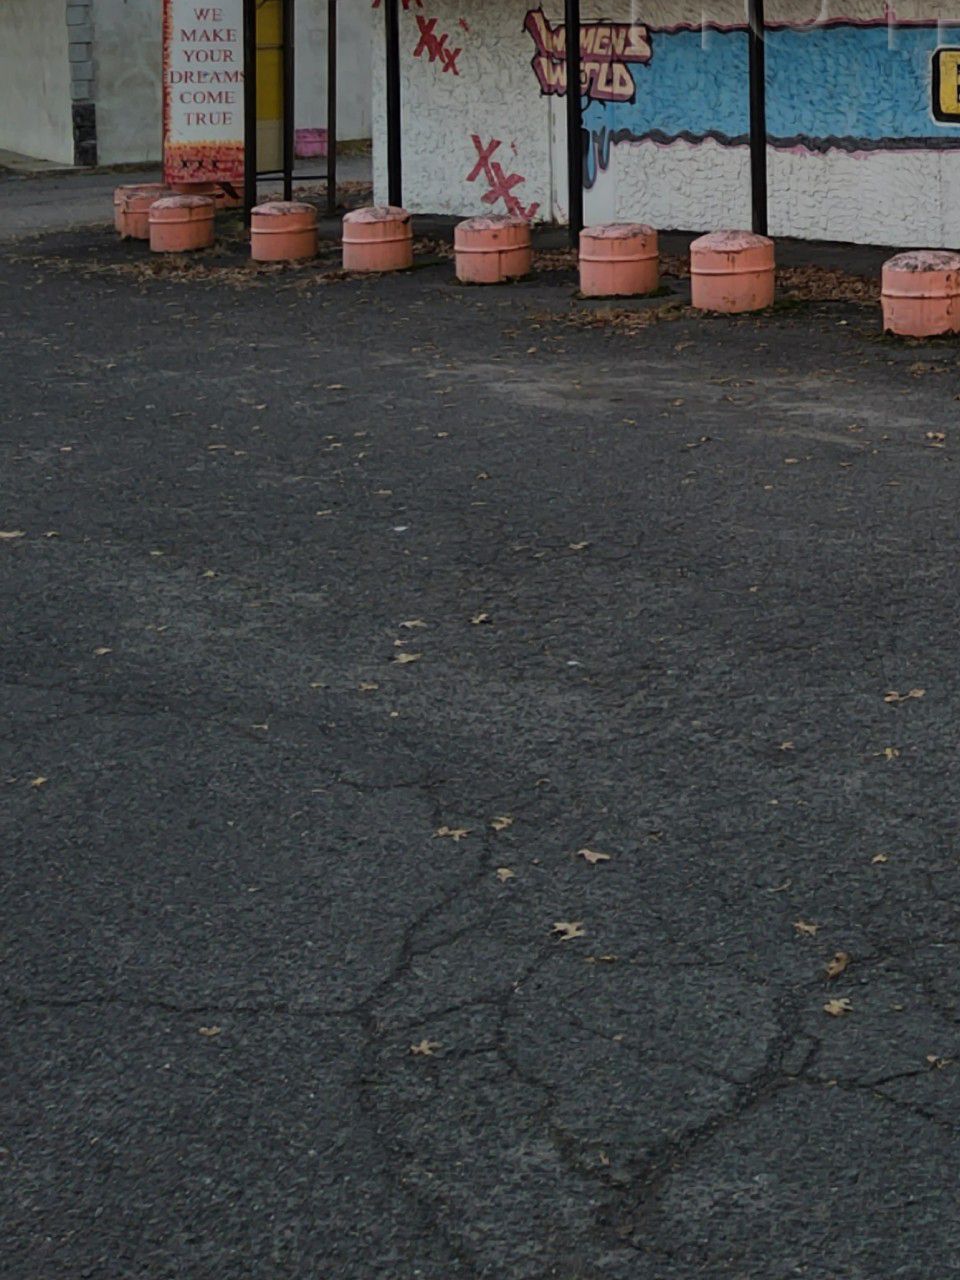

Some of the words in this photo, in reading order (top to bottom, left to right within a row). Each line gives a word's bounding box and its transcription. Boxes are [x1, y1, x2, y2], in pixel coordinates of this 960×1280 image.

[193, 8, 223, 22] WE
[180, 28, 236, 43] MAKE
[183, 49, 234, 63] YOUR
[170, 71, 245, 85] DREAMS
[179, 91, 236, 105] COME
[184, 112, 233, 126] TRUE
